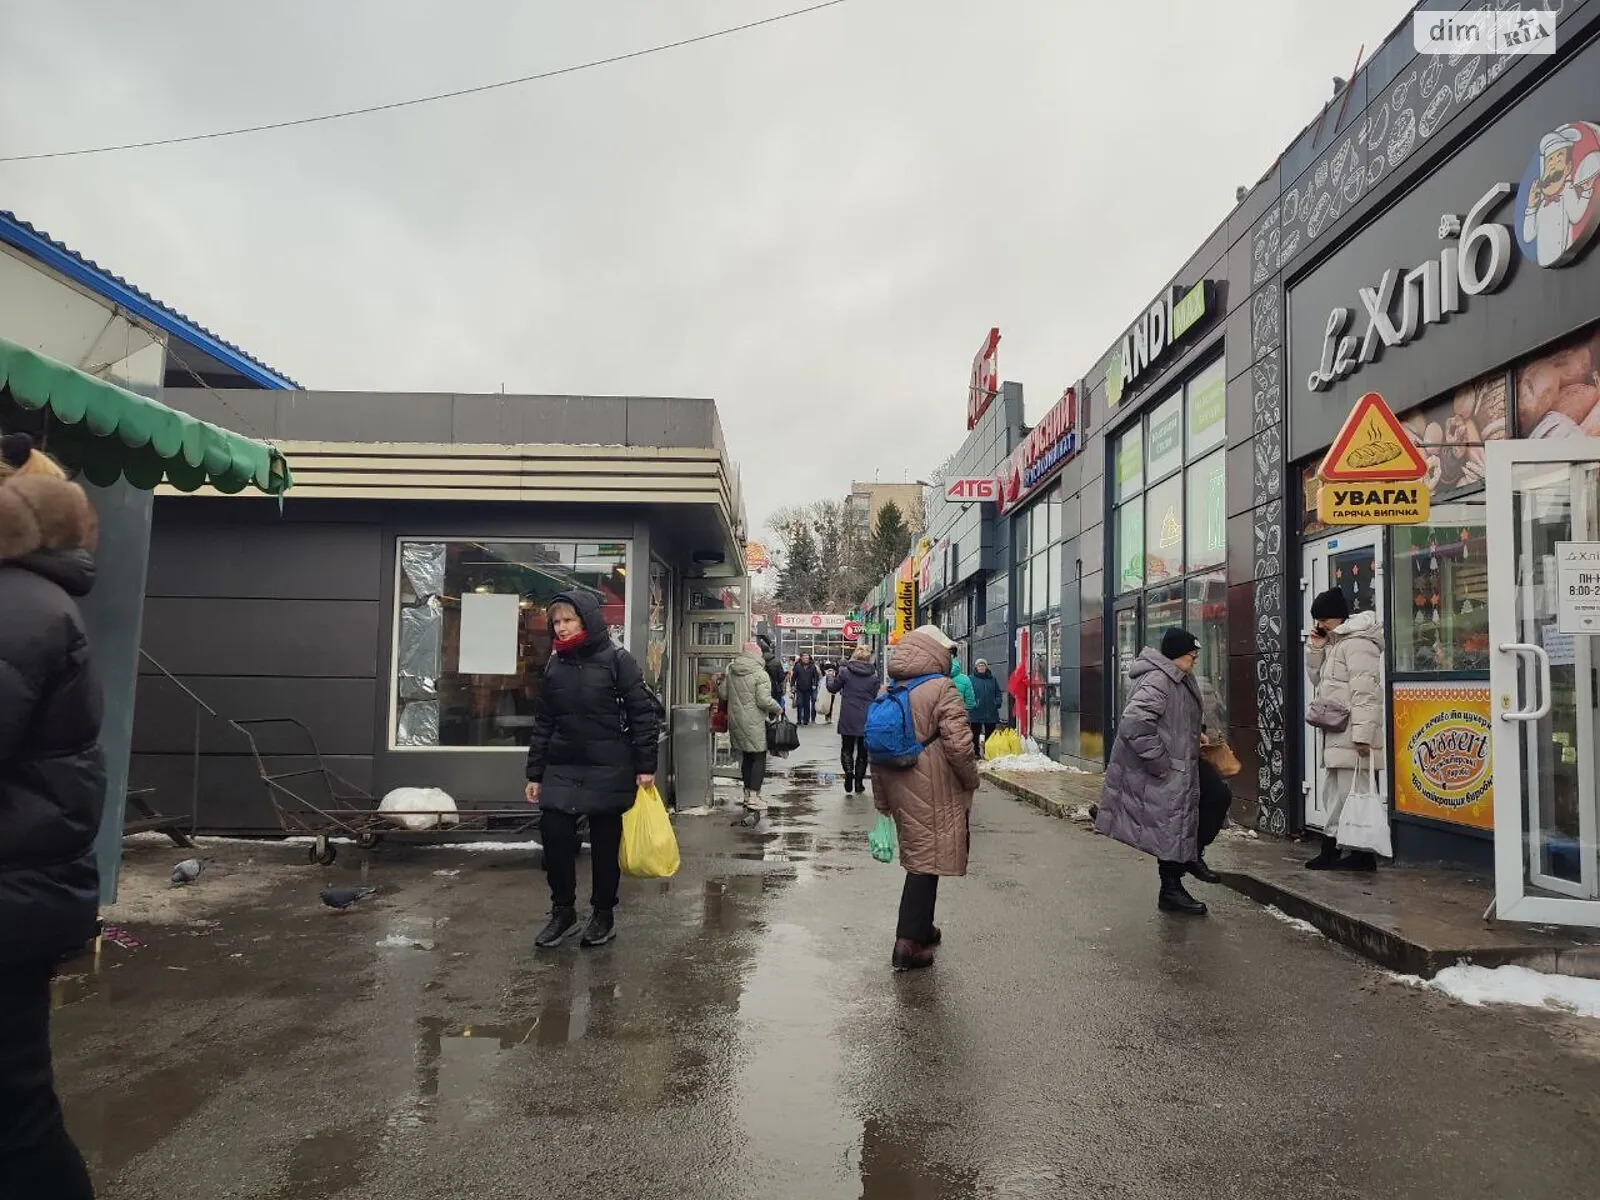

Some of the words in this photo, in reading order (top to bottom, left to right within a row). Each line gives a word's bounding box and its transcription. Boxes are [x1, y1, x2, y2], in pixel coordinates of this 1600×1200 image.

[1333, 489, 1418, 506] УВАГА!
[1333, 510, 1372, 518] ГАРЯЧА
[1374, 509, 1419, 517] ВИПІЧКА
[898, 581, 913, 634] andalini
